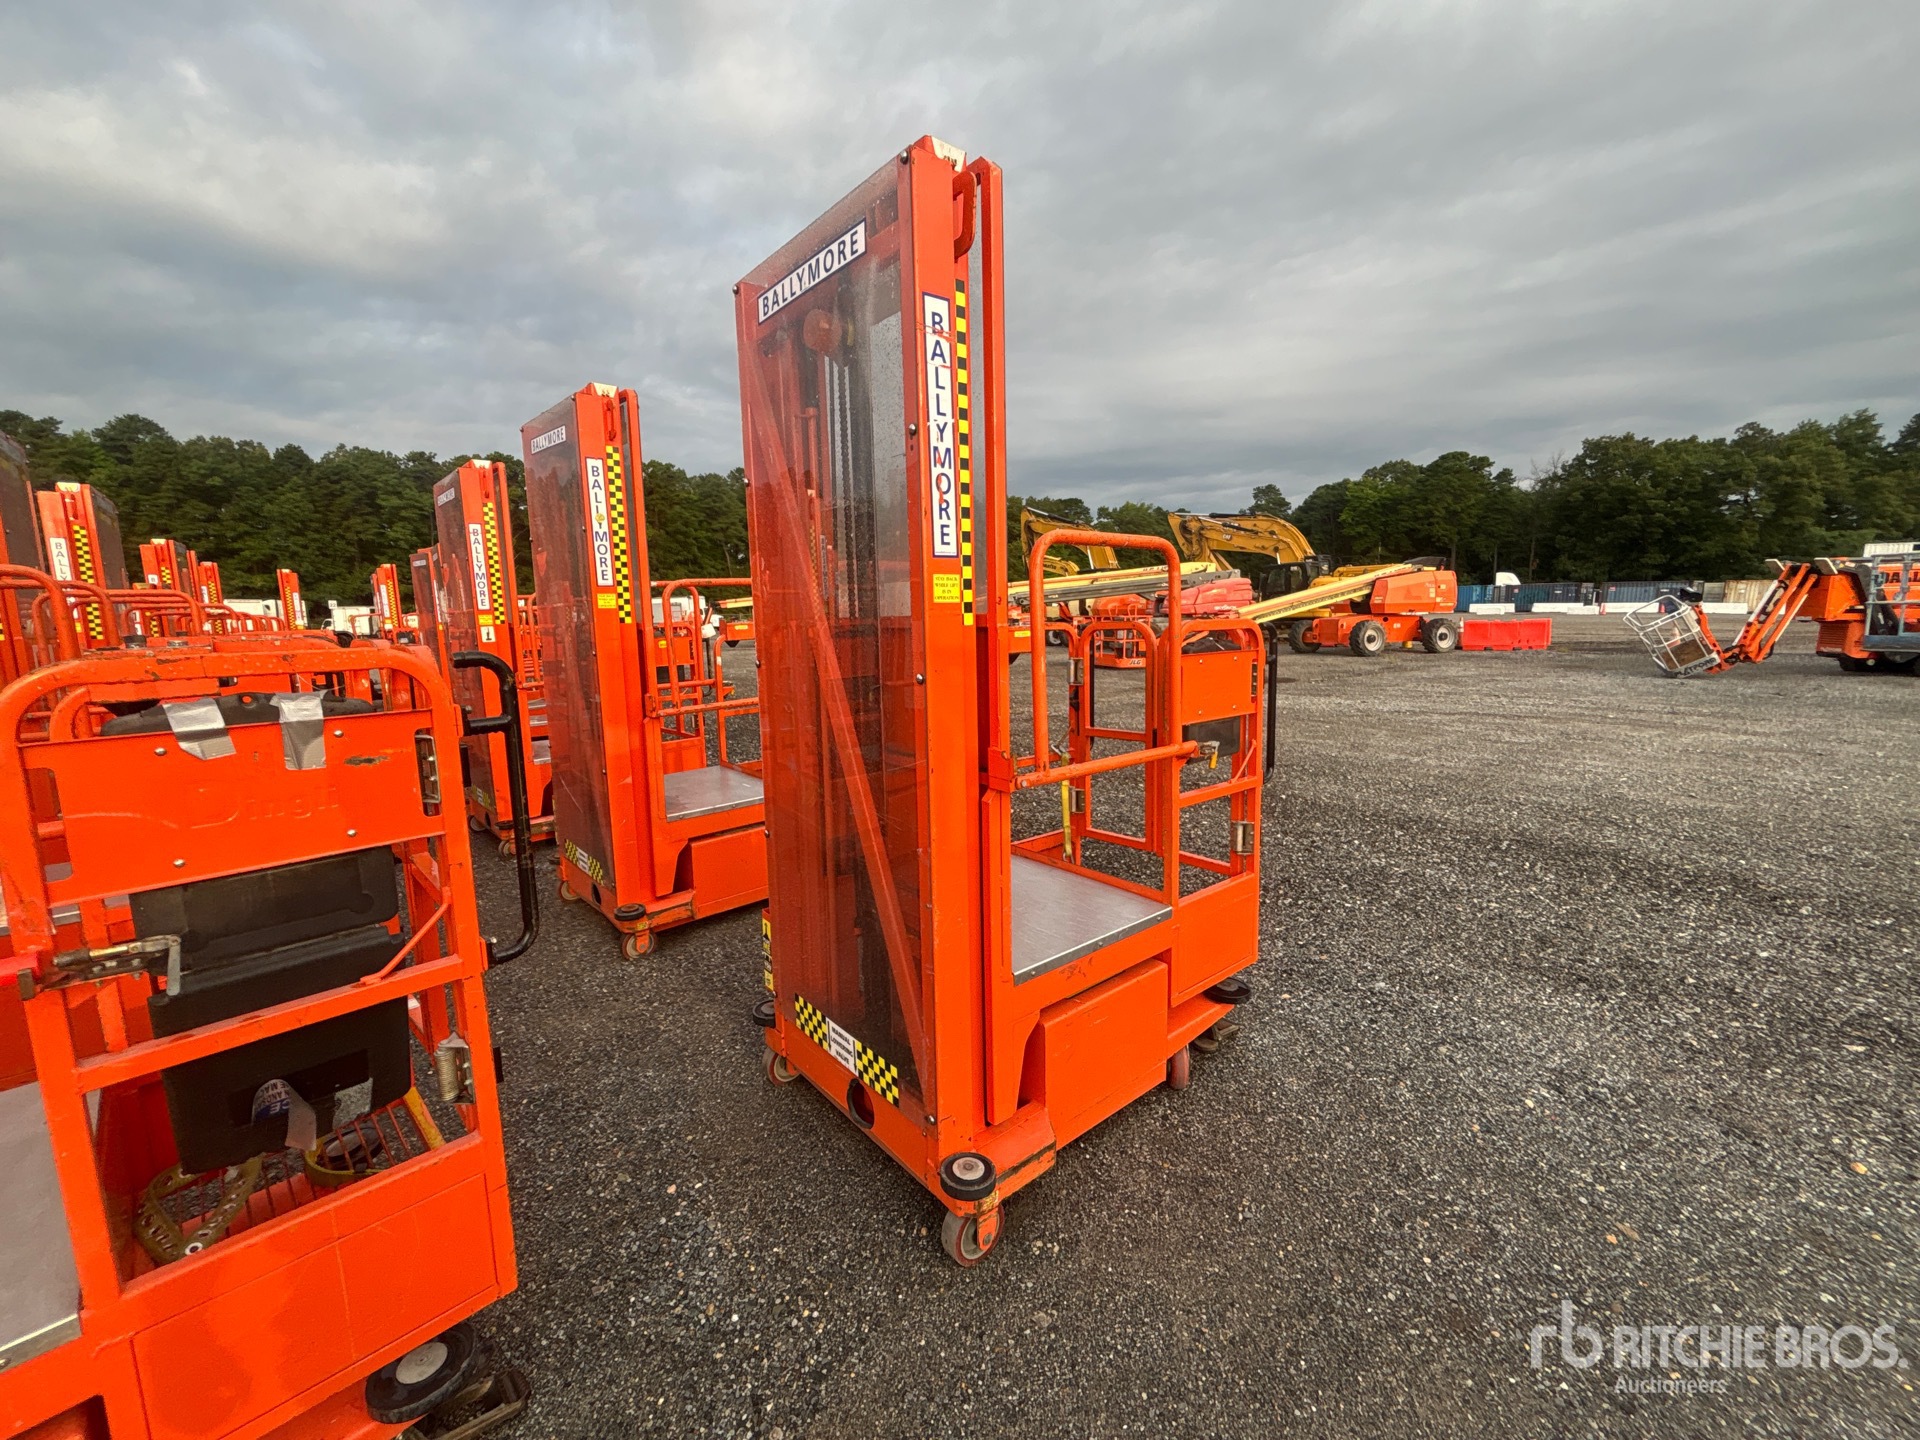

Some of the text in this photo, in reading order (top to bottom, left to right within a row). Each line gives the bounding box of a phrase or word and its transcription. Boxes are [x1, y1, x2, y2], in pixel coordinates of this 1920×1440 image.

[762, 229, 859, 317] BALLYMORE
[532, 426, 565, 453] BALLYMORE
[931, 311, 952, 546] BALLYMORE
[472, 528, 487, 607] BALLYMORE
[830, 1035, 853, 1057] LOWERING
[831, 1026, 851, 1046] MANUAL
[835, 1049, 850, 1065] VALVE
